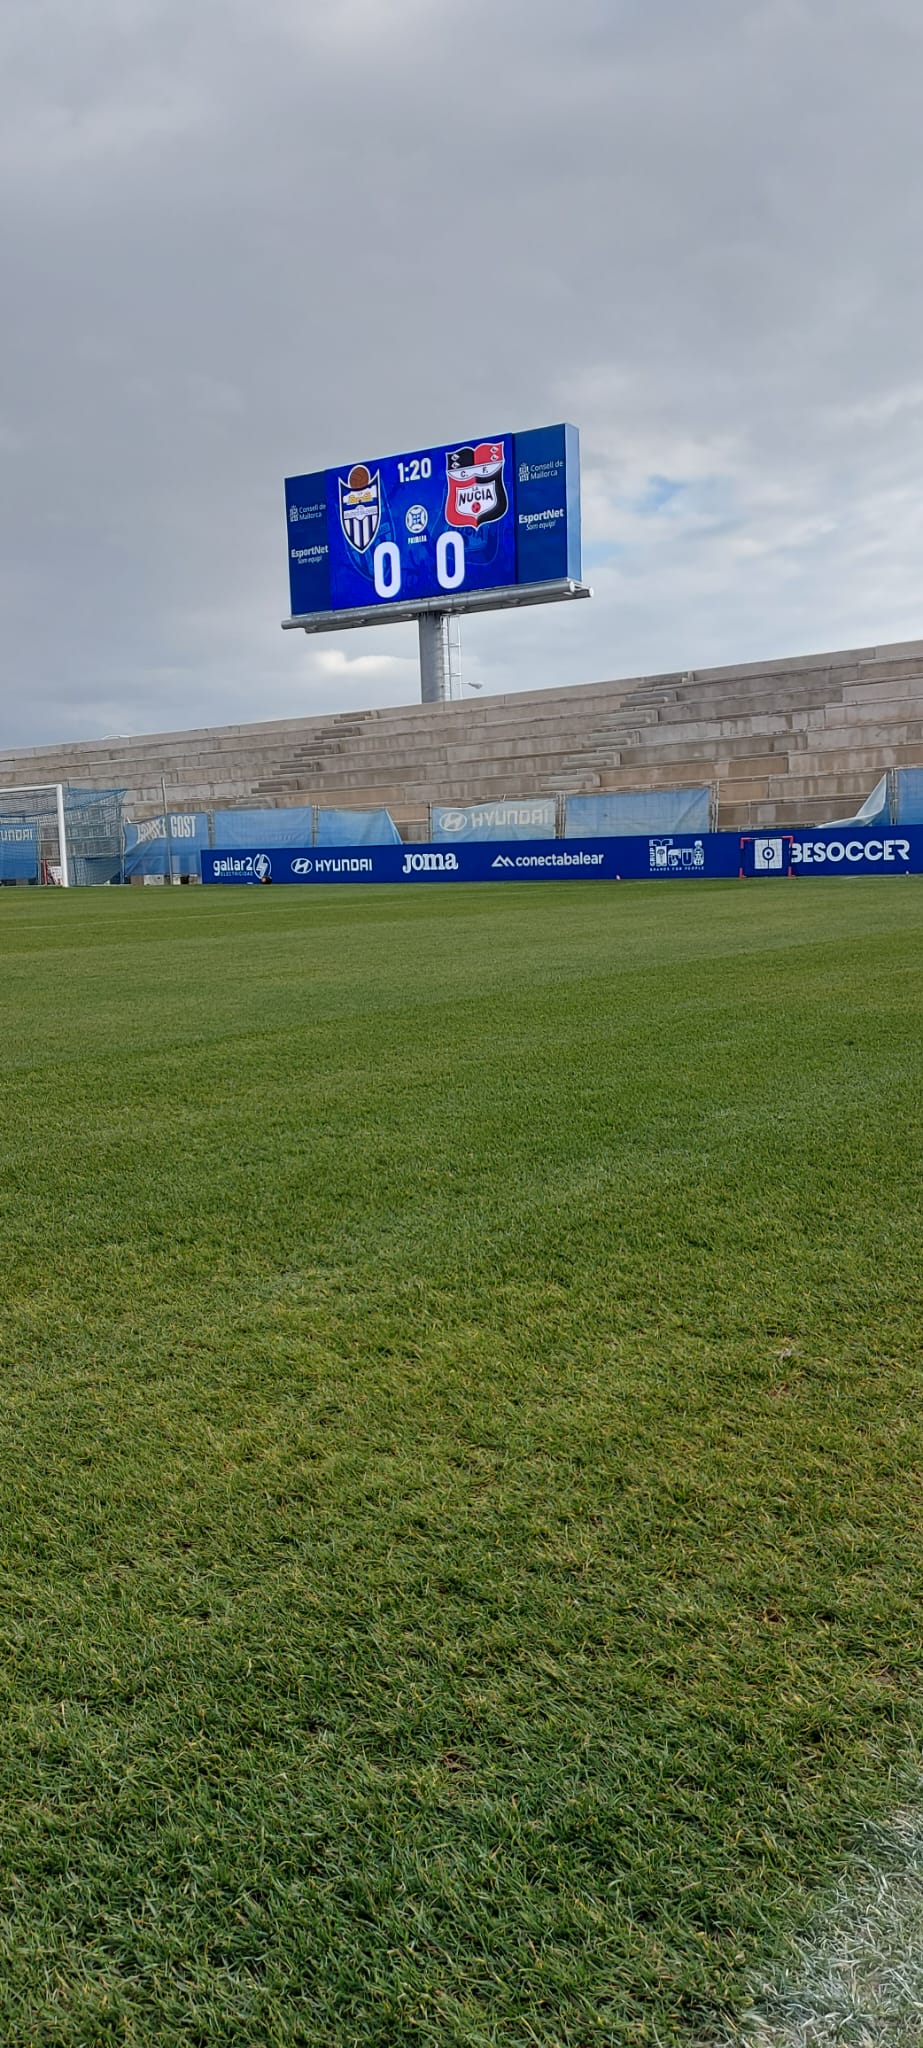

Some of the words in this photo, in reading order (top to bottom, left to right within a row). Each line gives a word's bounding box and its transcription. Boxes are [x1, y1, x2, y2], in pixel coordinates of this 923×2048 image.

[398, 457, 432, 482] 1:20
[530, 461, 554, 472] Consell
[555, 460, 564, 468] de
[530, 470, 558, 480] Mallorca
[298, 504, 319, 514] Consell
[299, 512, 322, 520] Mallorca
[519, 508, 564, 524] EsportNet
[291, 545, 329, 559] EsportNet
[436, 530, 465, 589] 0
[374, 541, 400, 598] 0
[471, 808, 550, 828] HYUNDAI
[170, 815, 196, 838] GOST
[790, 839, 910, 863] BESOCCER
[213, 857, 253, 876] gallar2
[315, 858, 373, 872] HYUNDAI
[515, 852, 604, 867] conectabalear
